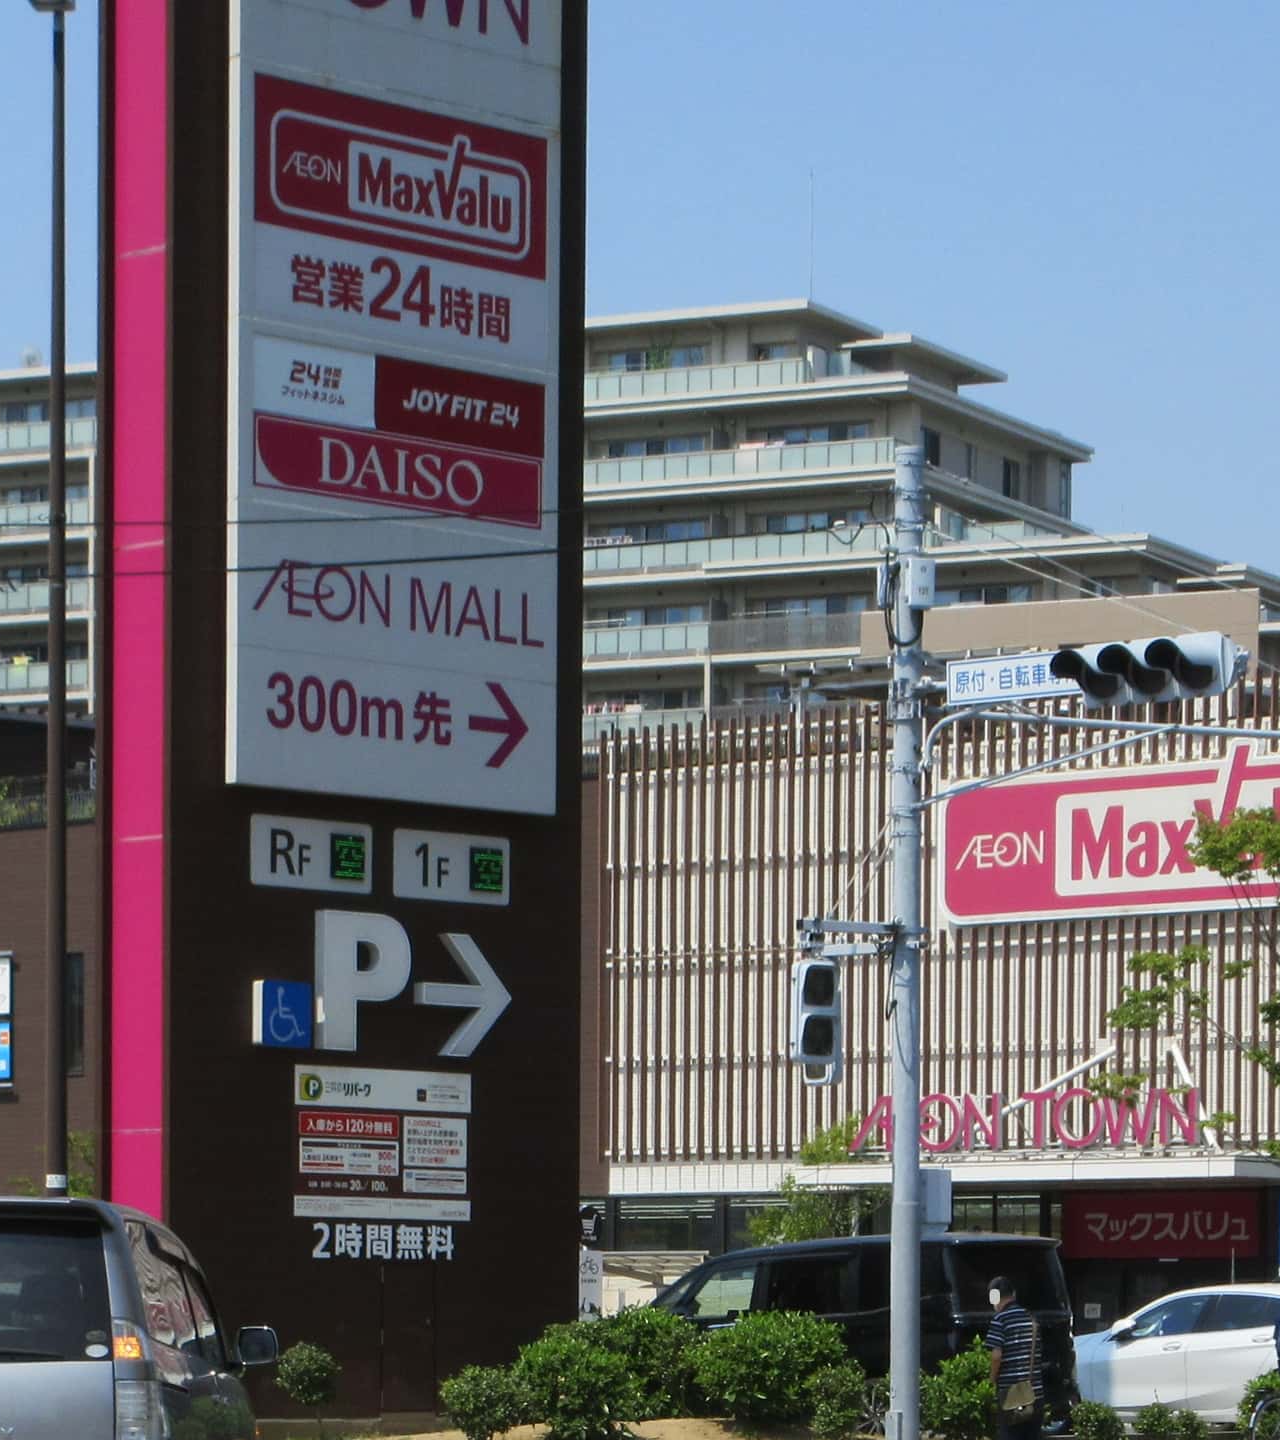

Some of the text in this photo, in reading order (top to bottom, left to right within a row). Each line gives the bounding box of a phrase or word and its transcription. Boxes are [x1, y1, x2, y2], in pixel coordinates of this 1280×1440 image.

[358, 140, 512, 234] MaxValu
[290, 253, 511, 344] 営業24時間
[319, 436, 484, 507] DAISO
[410, 576, 545, 649] MALL
[270, 829, 311, 877] RF
[415, 843, 450, 888] 1F
[314, 909, 412, 1051] P
[1022, 1087, 1199, 1149] TOWN
[312, 1222, 454, 1261] 2時間無料
[1084, 1211, 1250, 1242] マックスバリュ
